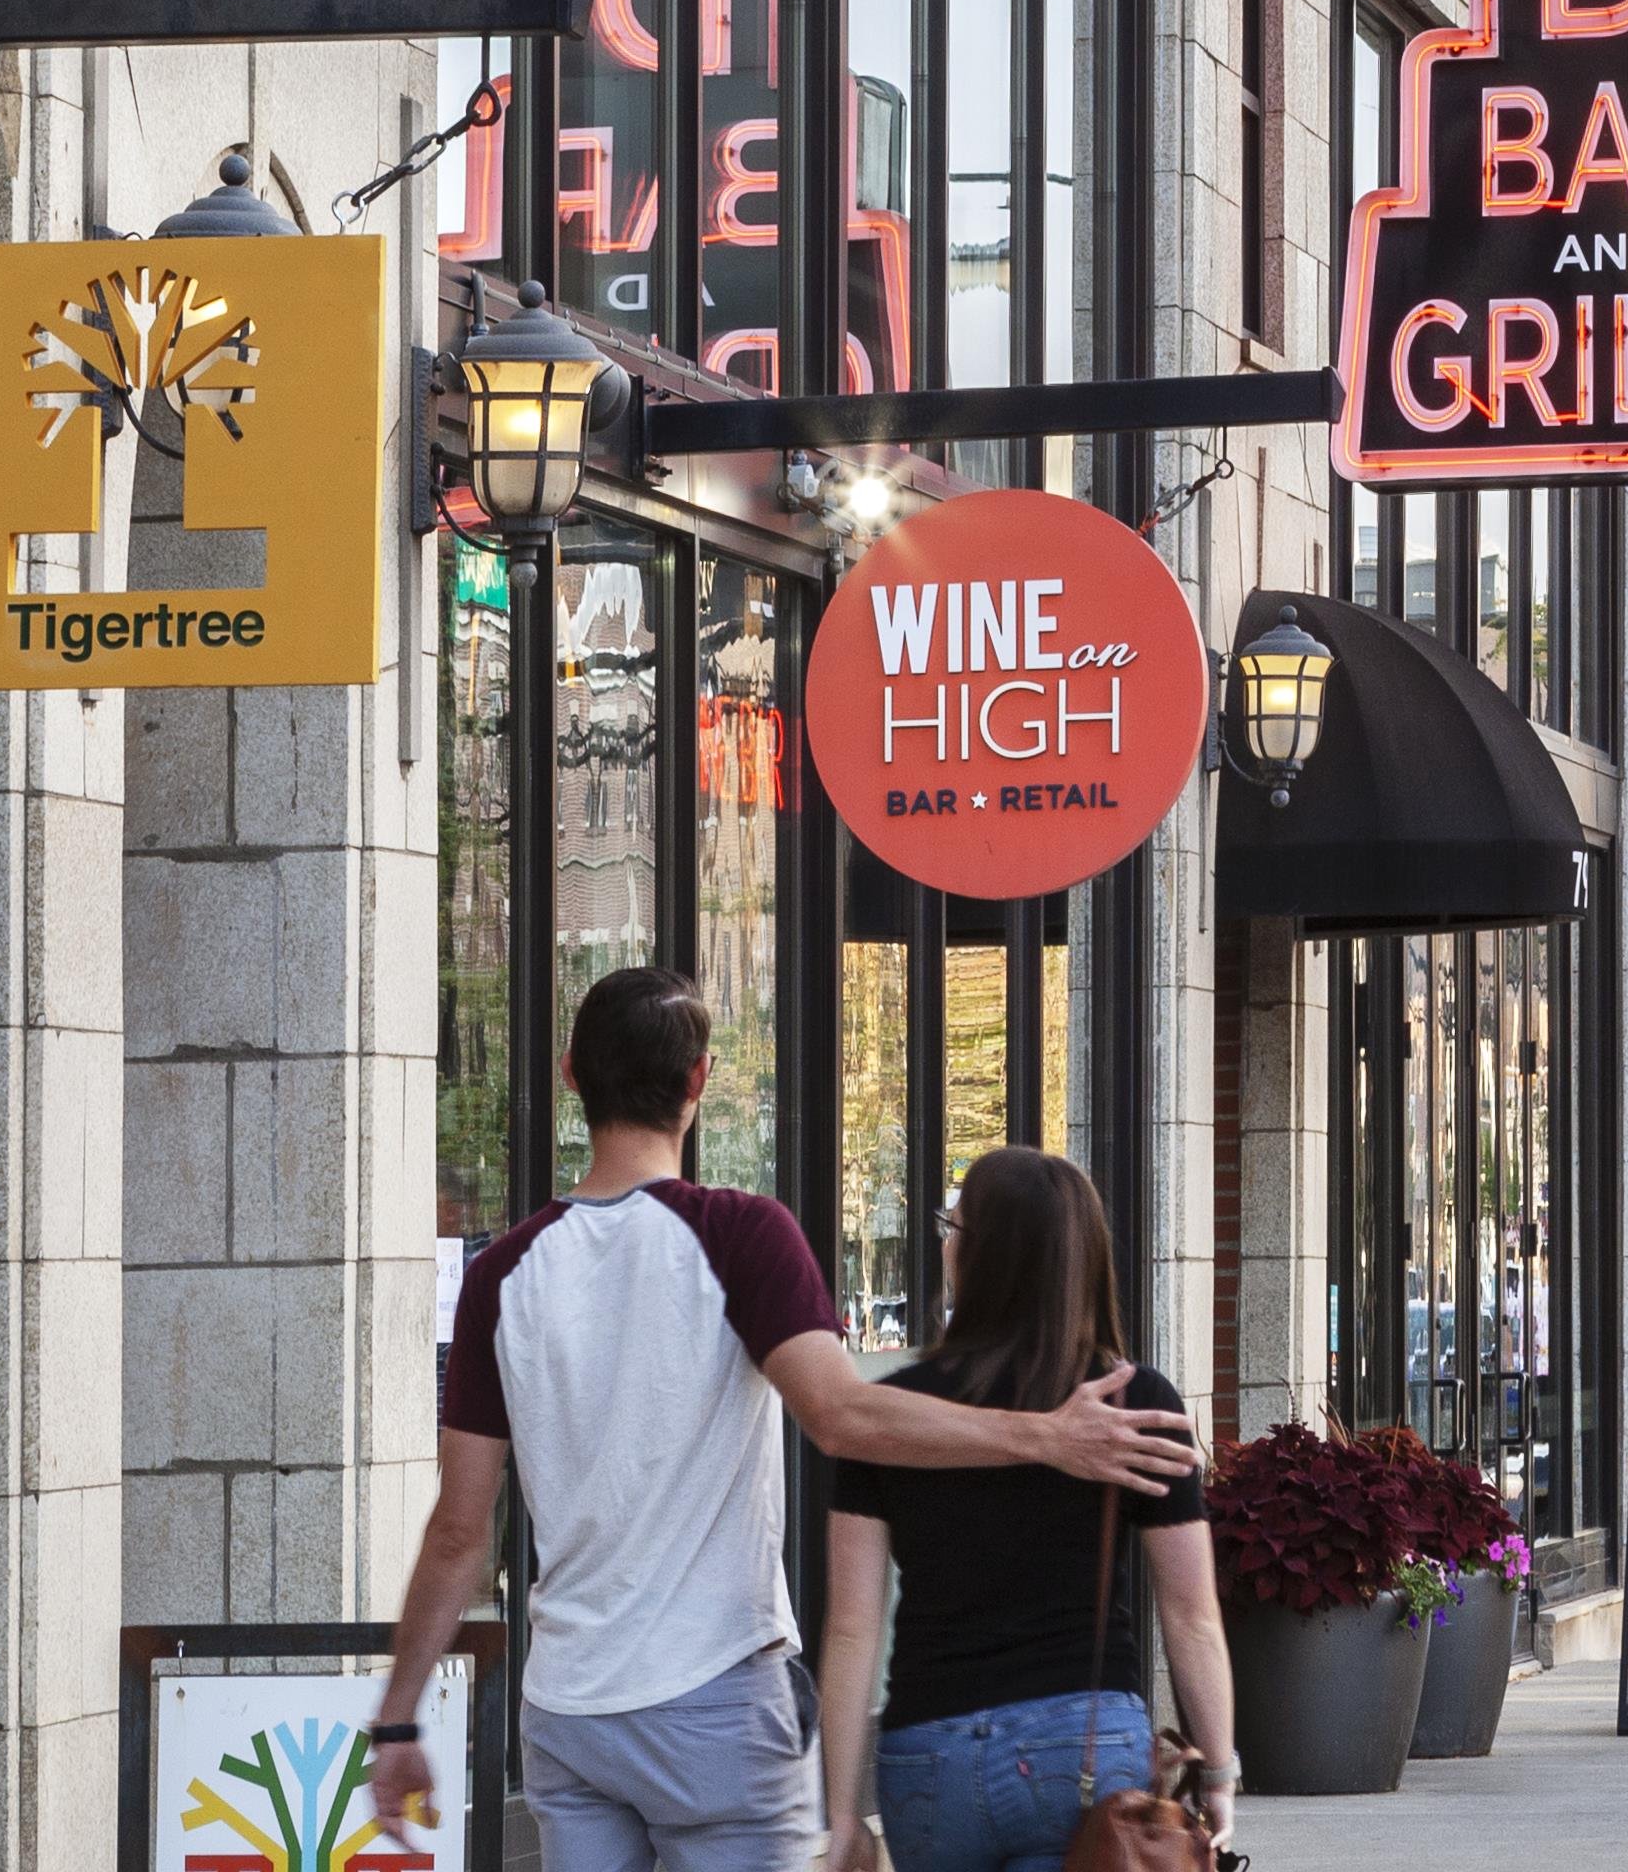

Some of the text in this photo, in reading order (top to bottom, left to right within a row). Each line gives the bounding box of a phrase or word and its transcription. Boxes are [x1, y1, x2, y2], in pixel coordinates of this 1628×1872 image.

[7, 602, 265, 664] Tigertree
[870, 577, 1139, 676] WINE on
[883, 676, 1121, 763] HIGH
[886, 781, 1119, 817] BAR RETAIL
